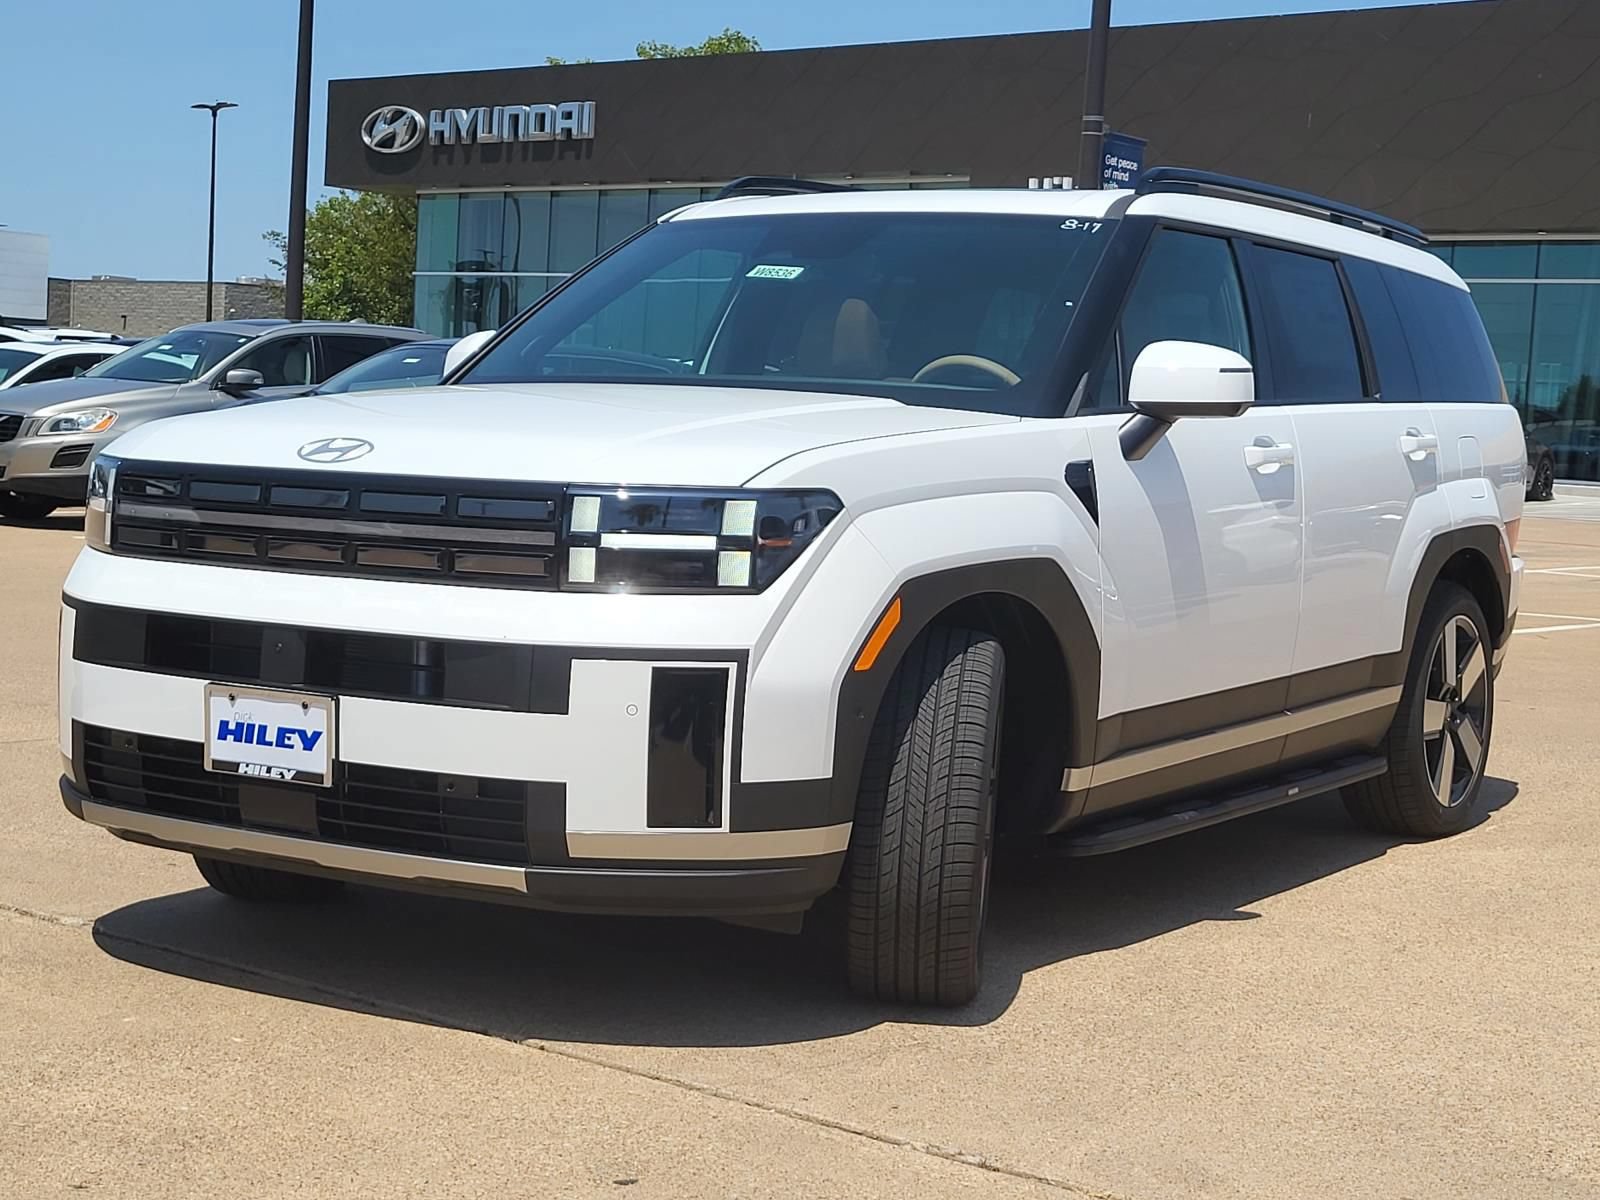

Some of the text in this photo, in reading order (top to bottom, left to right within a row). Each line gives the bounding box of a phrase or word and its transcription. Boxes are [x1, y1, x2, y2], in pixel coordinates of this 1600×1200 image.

[429, 101, 596, 145] HYUNDAI
[1105, 154, 1138, 171] Get peace
[1104, 167, 1129, 181] of mind
[1060, 218, 1102, 233] 8-17
[218, 720, 322, 751] HILEY
[238, 763, 296, 780] HILEY
